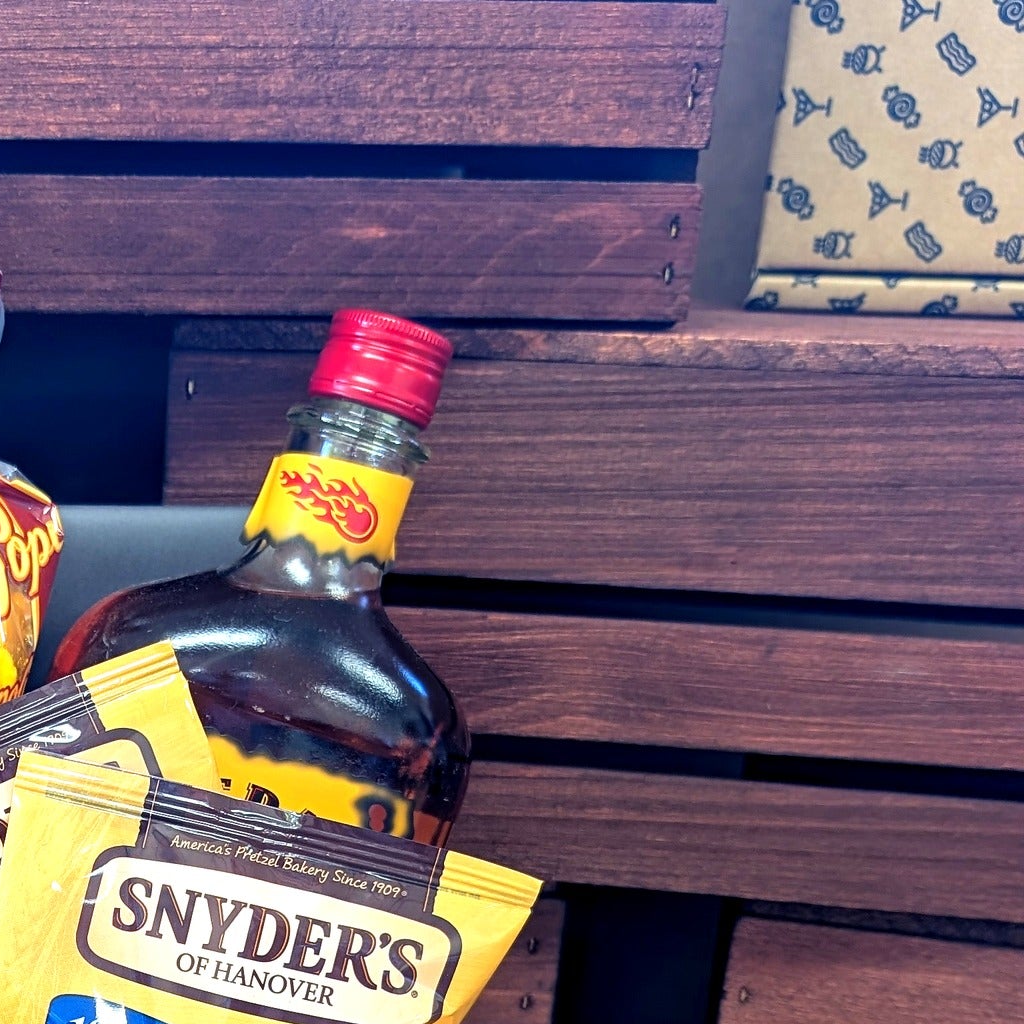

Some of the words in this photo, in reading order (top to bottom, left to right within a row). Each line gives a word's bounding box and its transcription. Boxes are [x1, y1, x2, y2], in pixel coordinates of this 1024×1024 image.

[170, 834, 232, 856] America's
[235, 845, 279, 867] Pretzel
[282, 857, 329, 884] Bakery
[333, 870, 367, 890] Since
[112, 876, 424, 995] SNYDER'S
[176, 952, 209, 976] OF
[213, 960, 335, 1007] HANOVER
